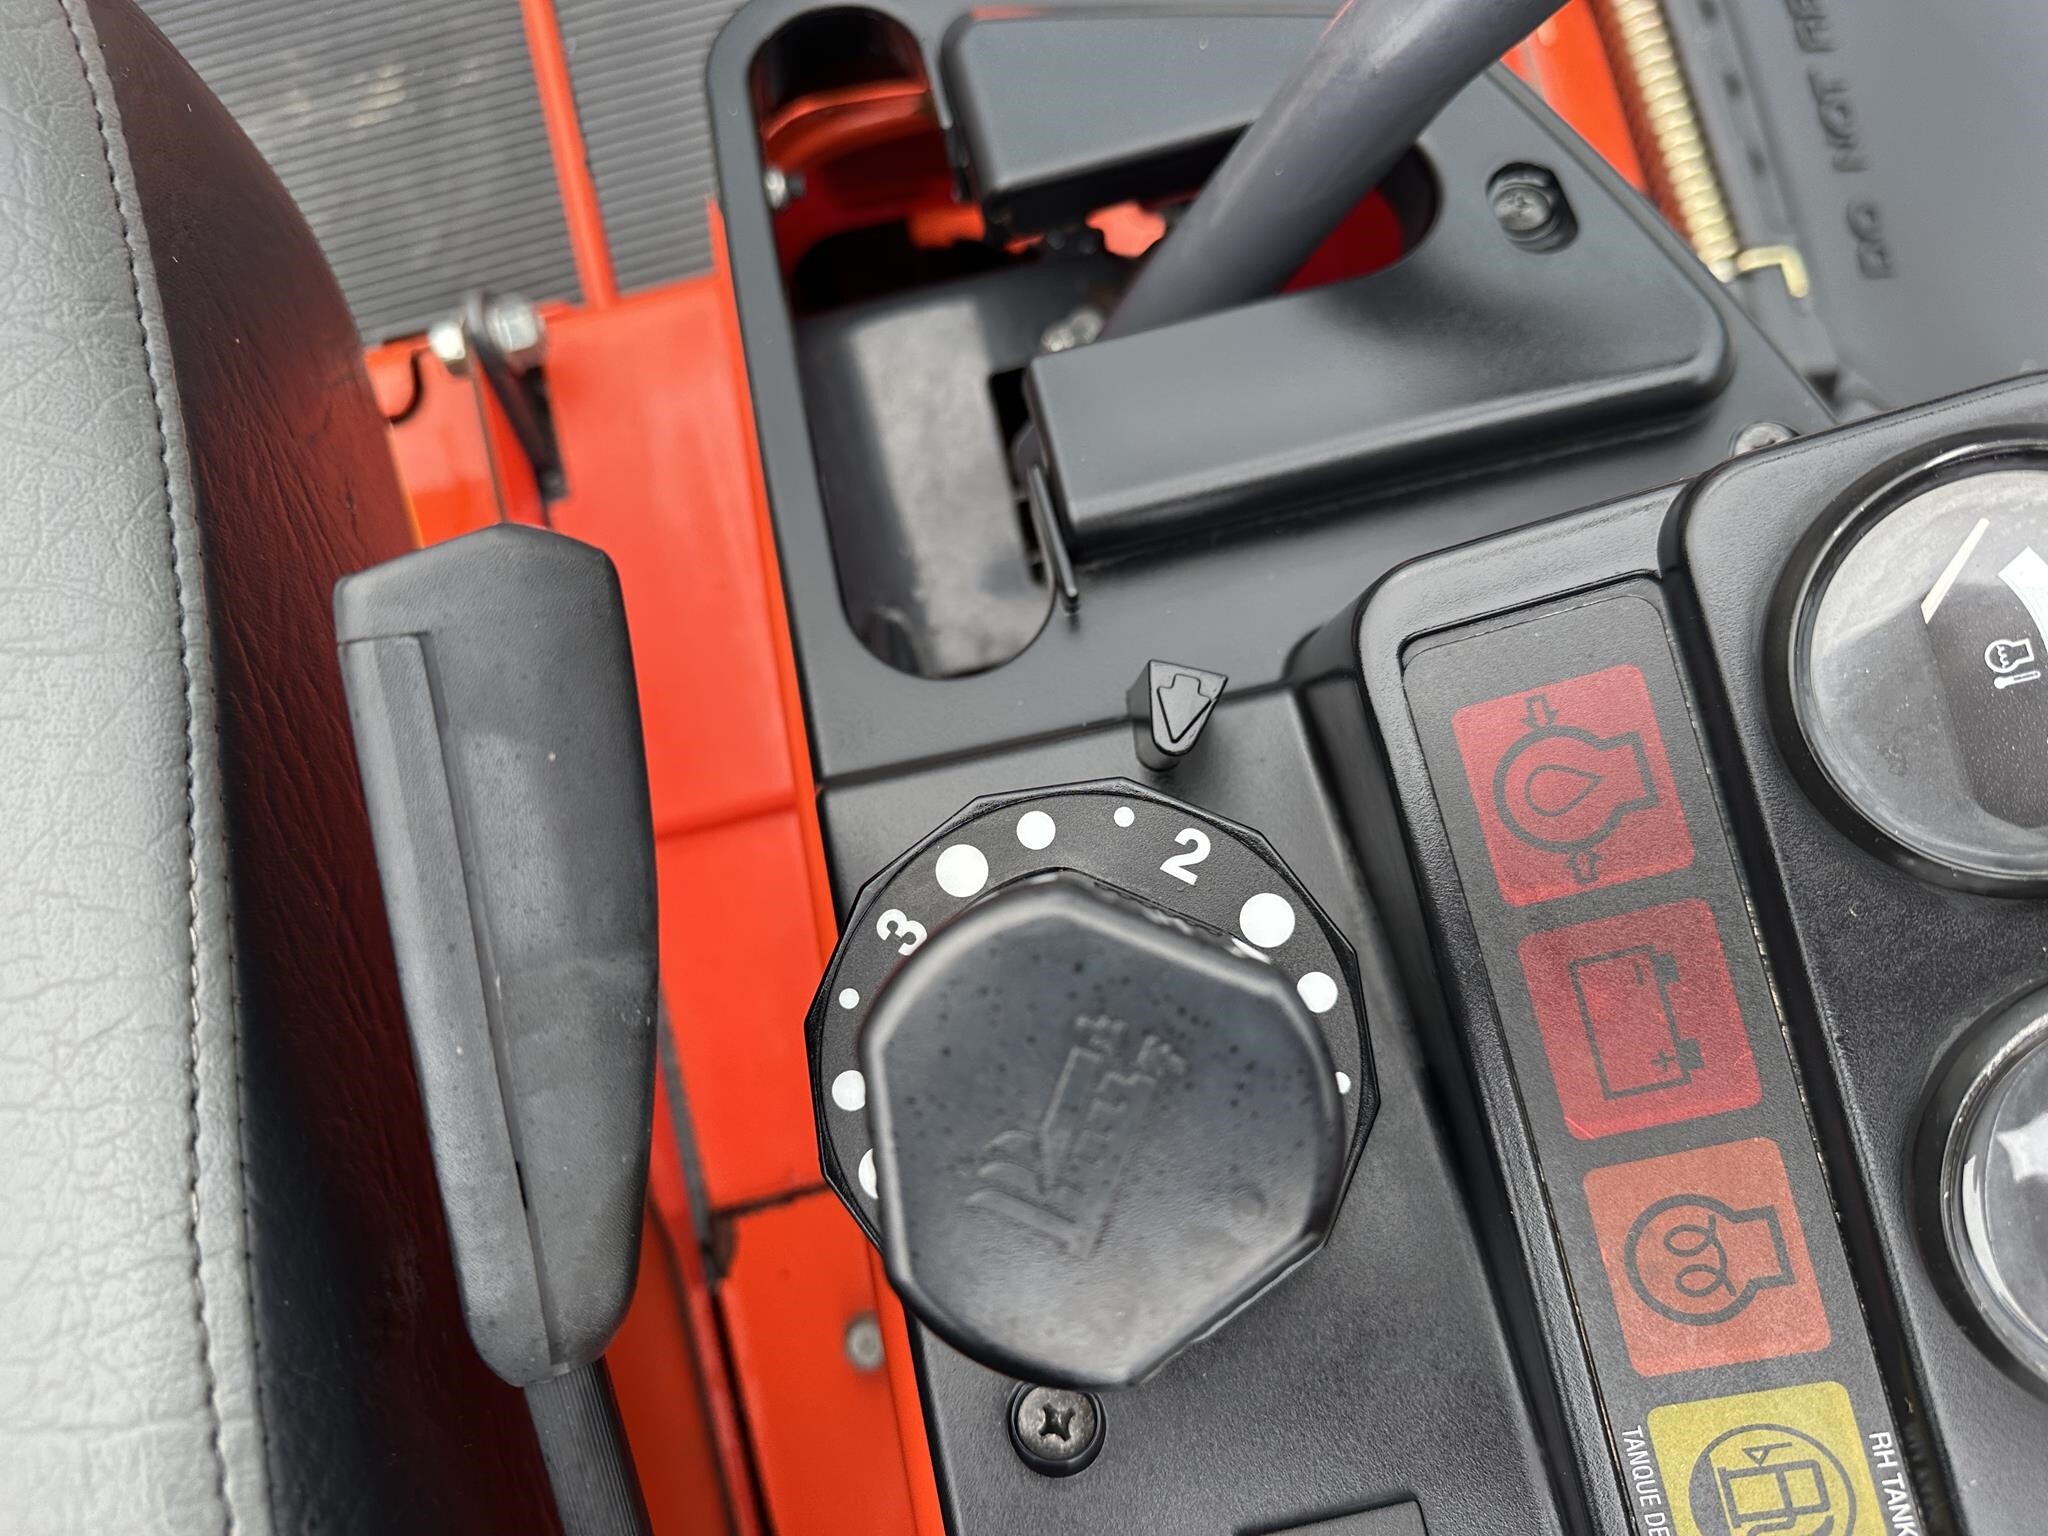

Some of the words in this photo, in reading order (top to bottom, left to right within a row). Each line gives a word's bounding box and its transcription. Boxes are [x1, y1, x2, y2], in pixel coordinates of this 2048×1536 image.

[1807, 65, 1870, 174] NOT
[1846, 200, 1897, 281] DO
[1159, 827, 1212, 887] 2
[875, 908, 928, 957] 3
[1621, 1424, 1662, 1507] TANQUE
[1868, 1431, 1899, 1469] RH
[1881, 1471, 1919, 1536] TANK
